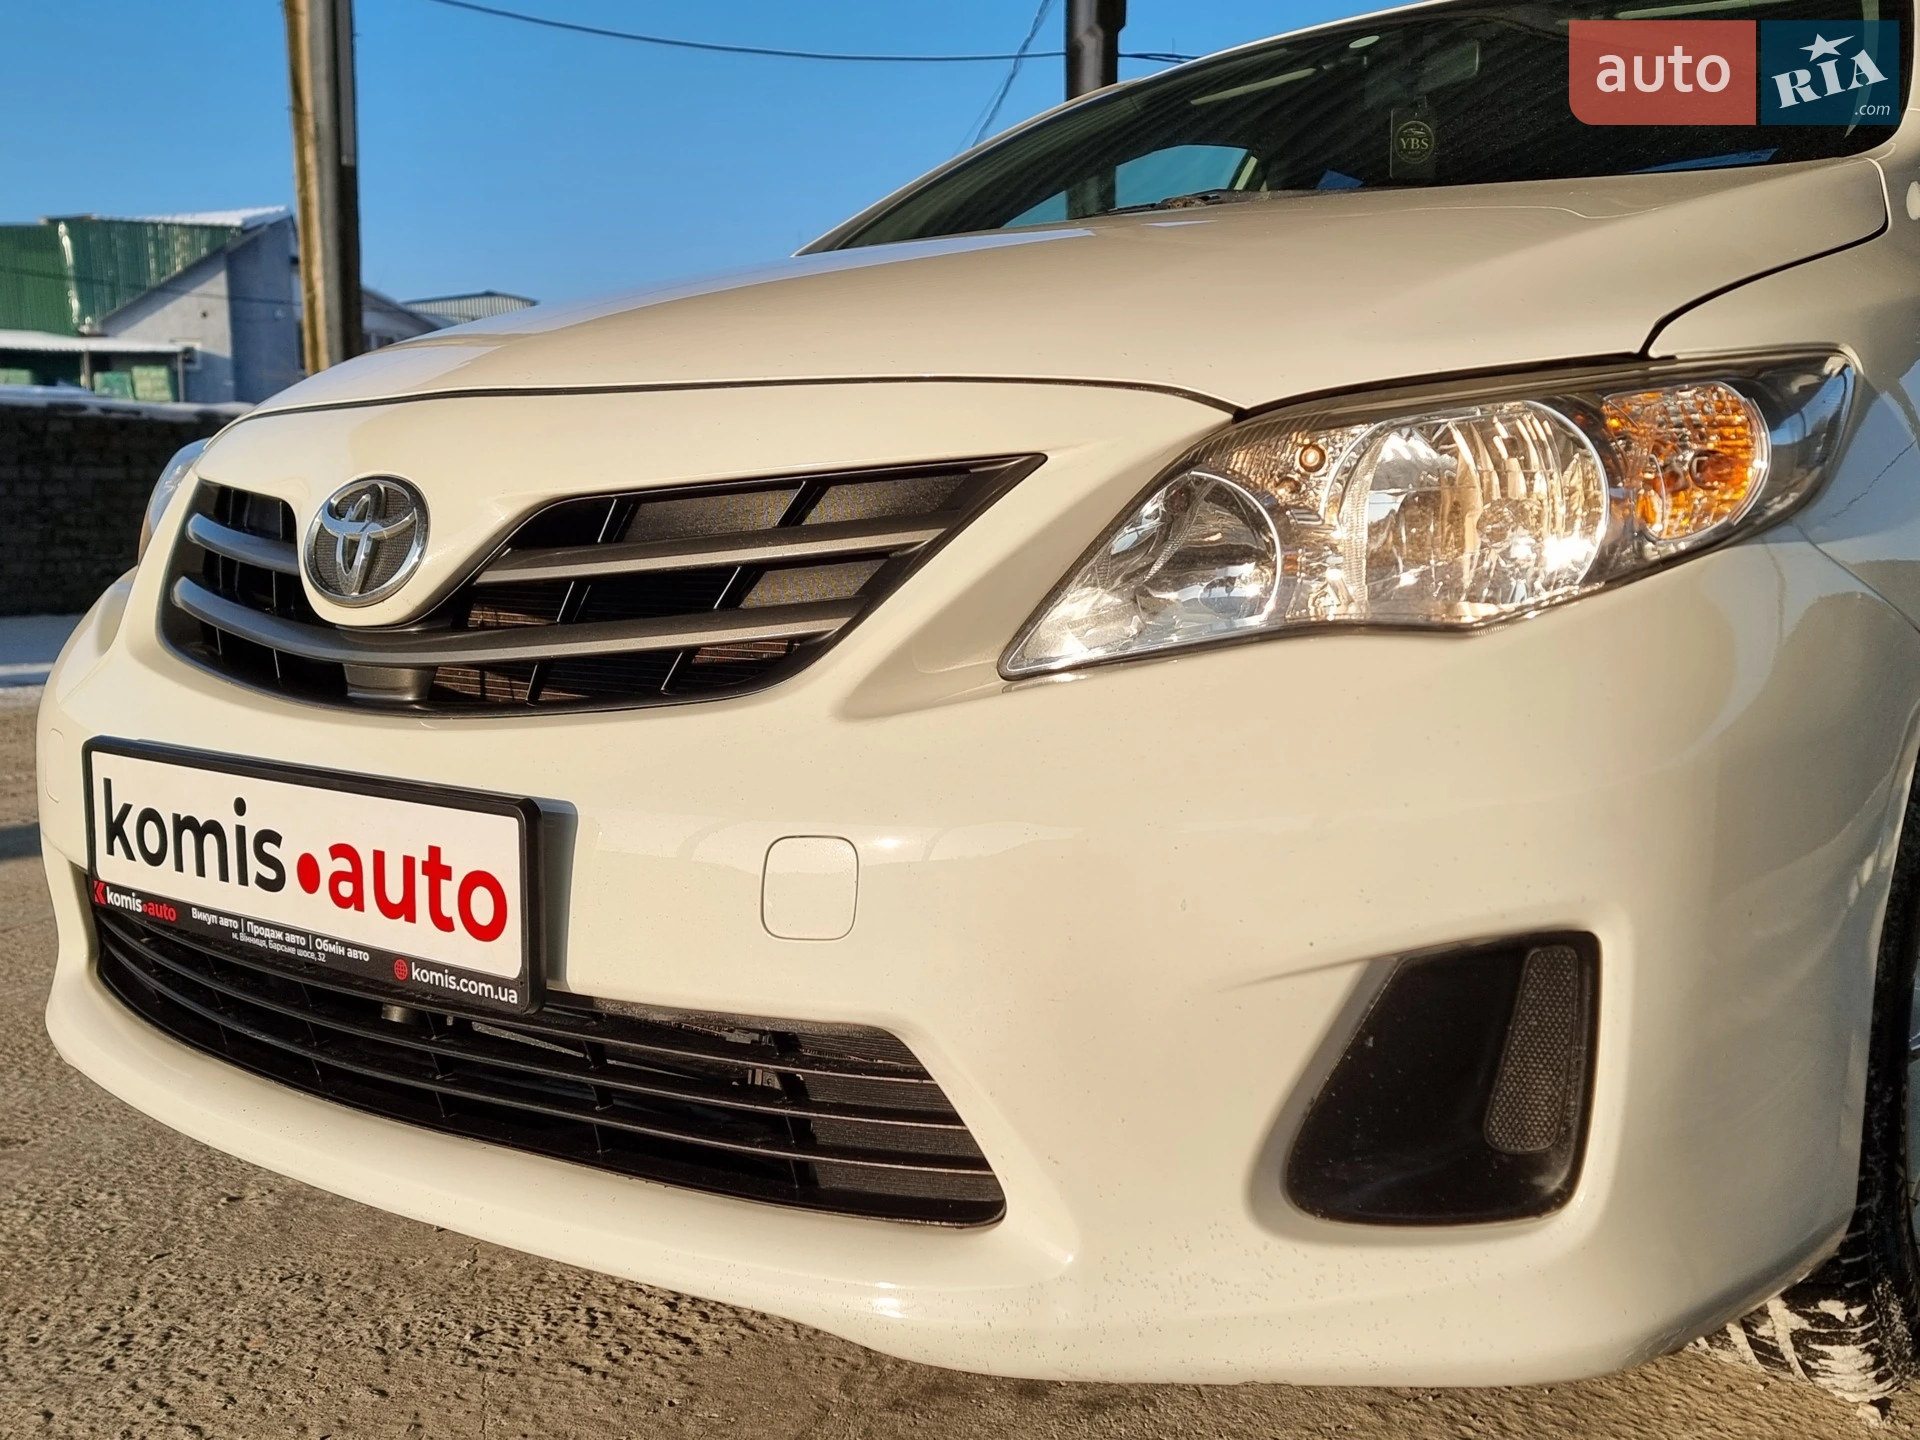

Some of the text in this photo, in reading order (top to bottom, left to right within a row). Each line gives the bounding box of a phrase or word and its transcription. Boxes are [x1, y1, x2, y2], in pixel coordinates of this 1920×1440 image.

[1400, 137, 1429, 150] YBS
[191, 907, 370, 962] Викуп авто Продаж авто Обмін авто
[317, 951, 326, 962] 32
[411, 962, 518, 1004] komis.com.ua
